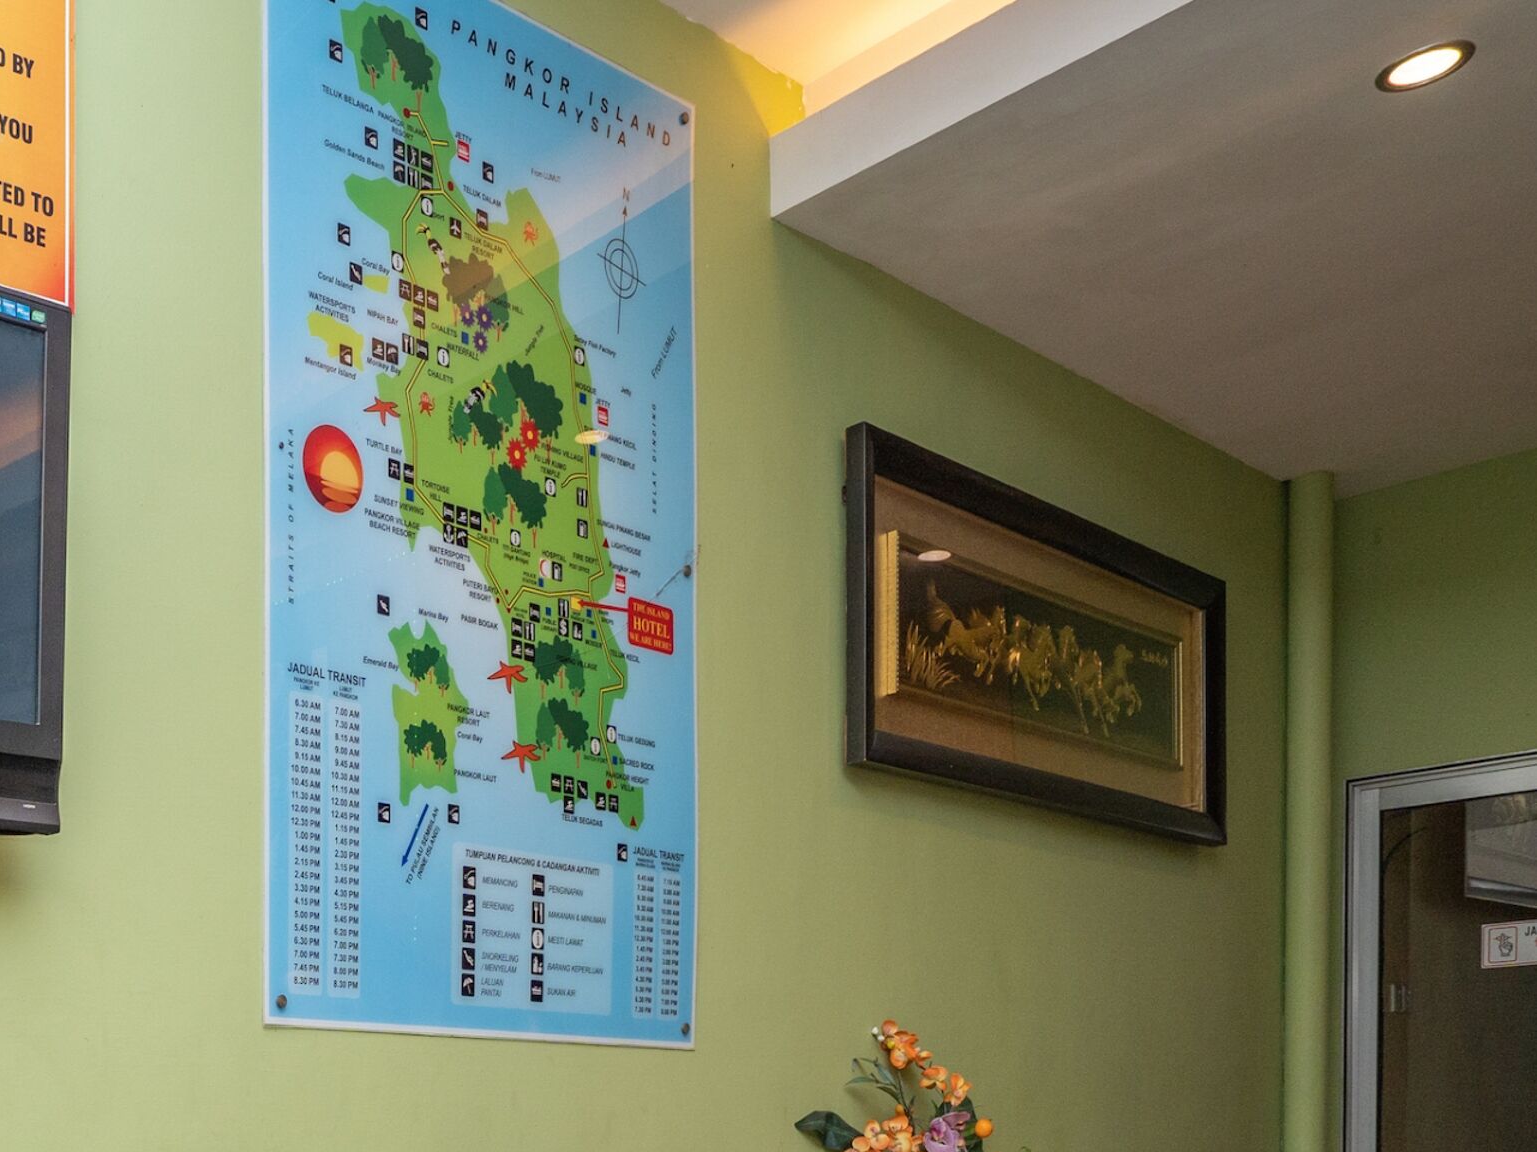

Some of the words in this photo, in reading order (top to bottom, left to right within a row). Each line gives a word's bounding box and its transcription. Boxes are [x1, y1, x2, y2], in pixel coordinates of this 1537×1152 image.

[12, 53, 35, 79] BY
[451, 20, 570, 94] PANGKOR
[589, 91, 671, 147] ISLAND
[504, 72, 627, 147] MALAYSIA
[31, 191, 55, 218] TO
[23, 222, 47, 247] BE
[633, 616, 670, 639] HOTEL
[287, 662, 325, 679] JADUAL
[328, 670, 366, 687] TRANSIT
